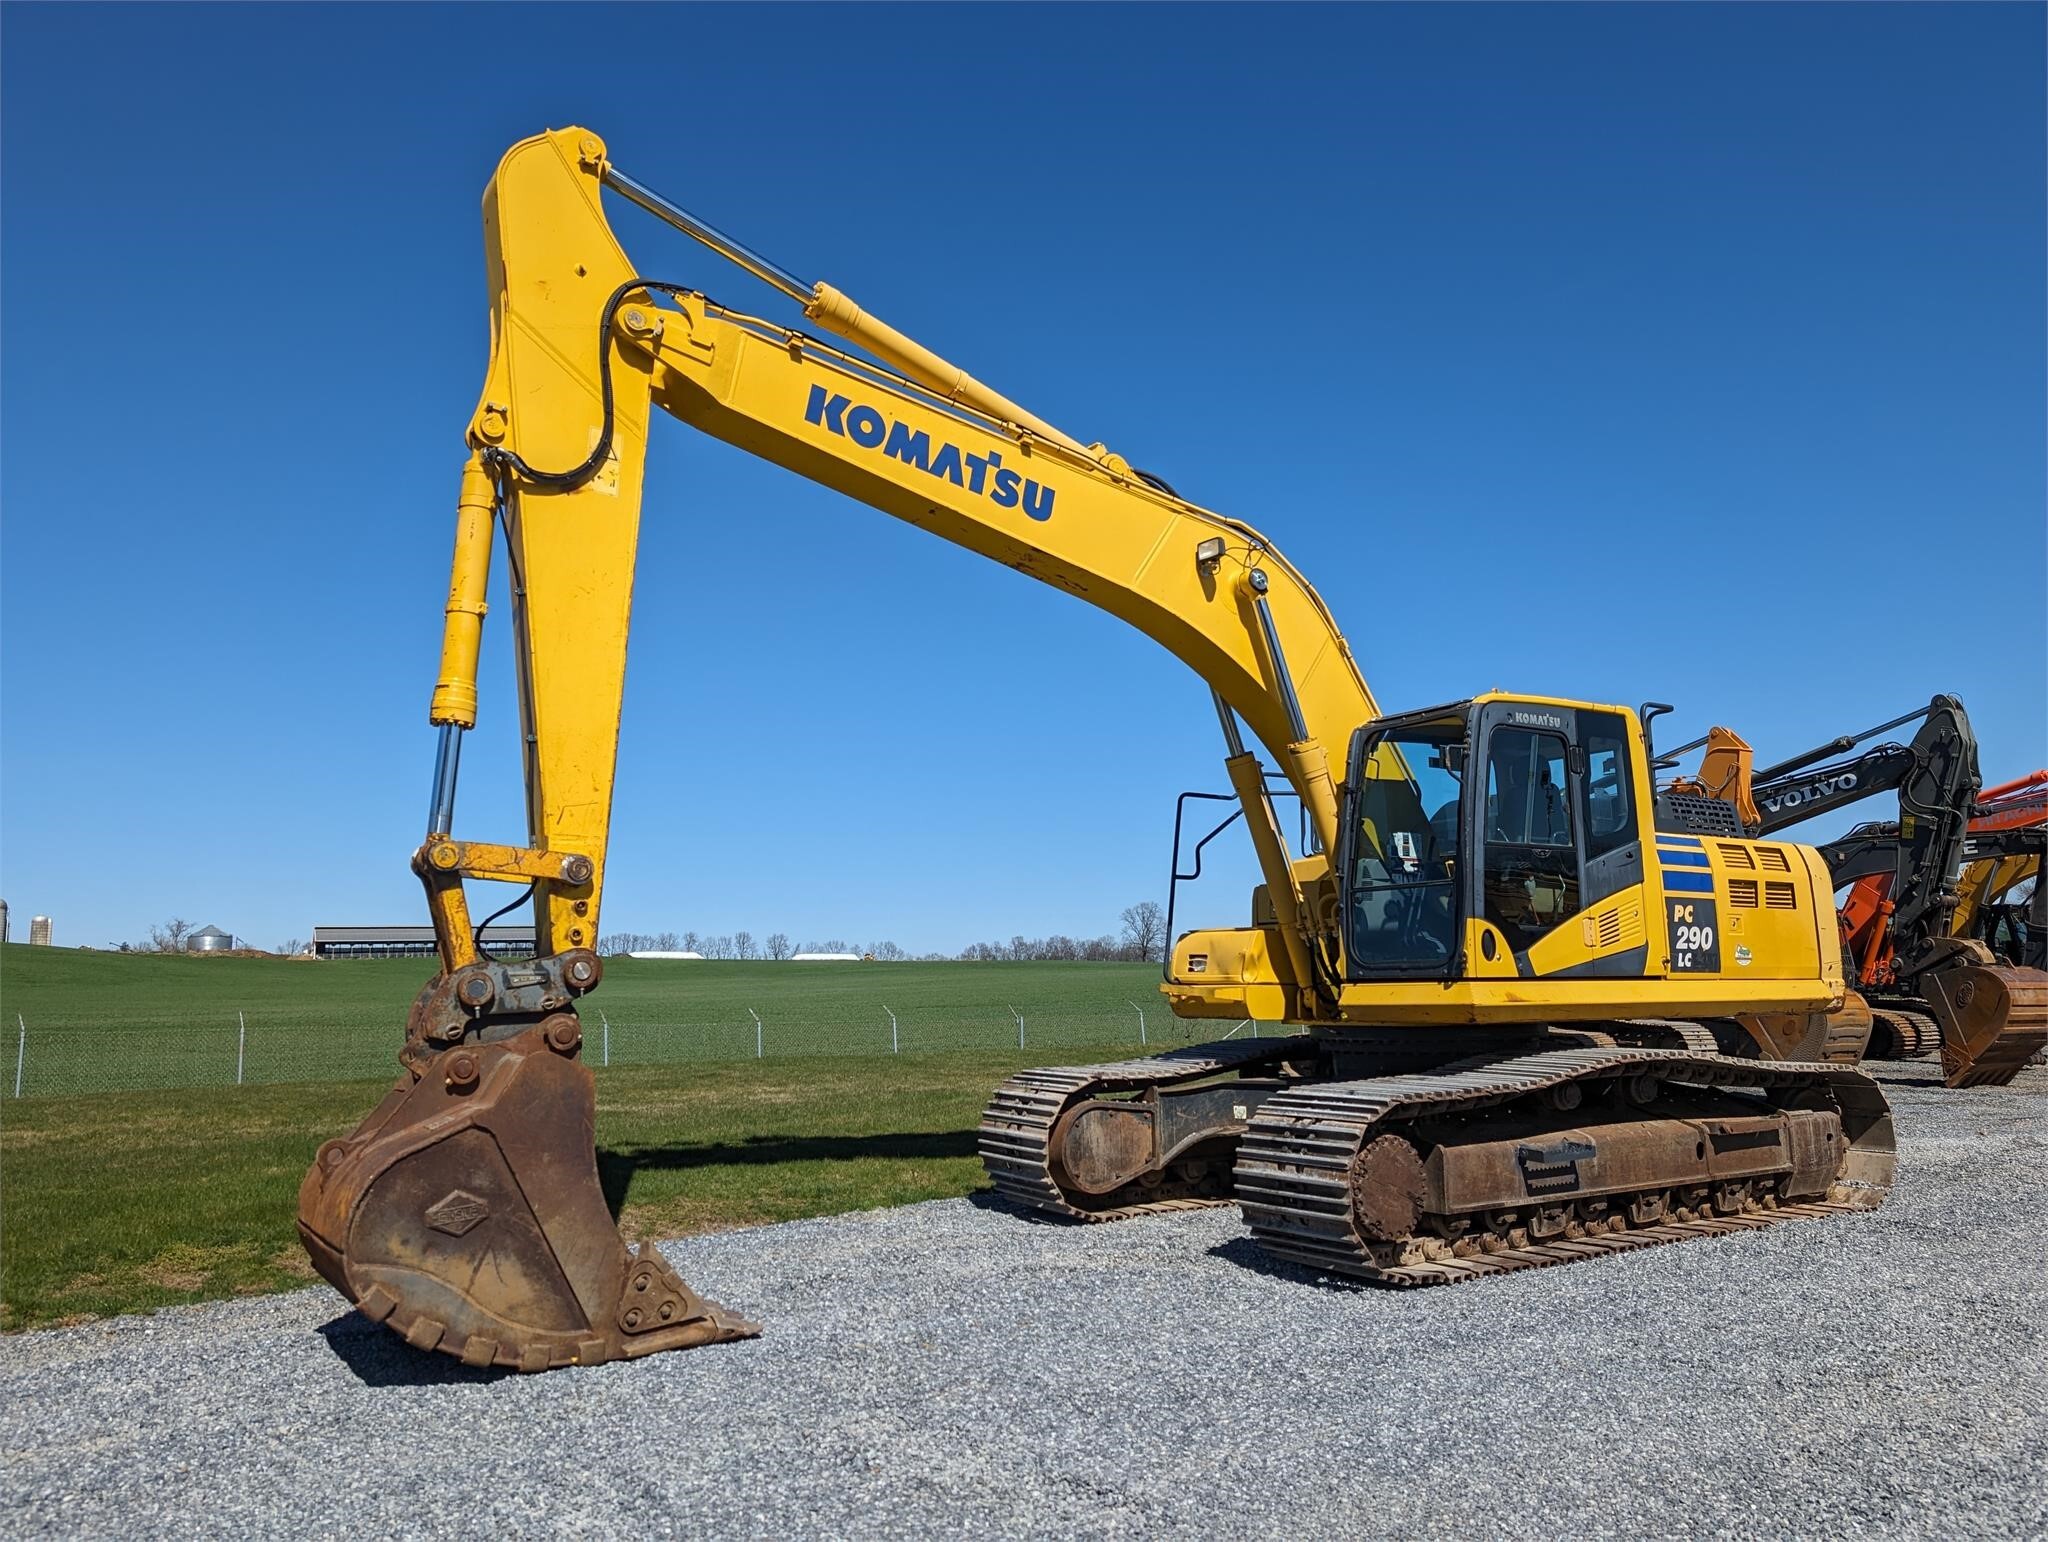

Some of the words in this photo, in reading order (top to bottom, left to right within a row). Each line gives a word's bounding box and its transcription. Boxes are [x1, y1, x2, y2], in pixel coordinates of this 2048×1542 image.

[804, 383, 1056, 522] KOMATSU
[1515, 712, 1561, 728] KOMATSU
[1761, 773, 1858, 813] VOLVO
[1674, 904, 1694, 923] PC
[1676, 926, 1713, 951] 290
[1677, 953, 1692, 968] LC
